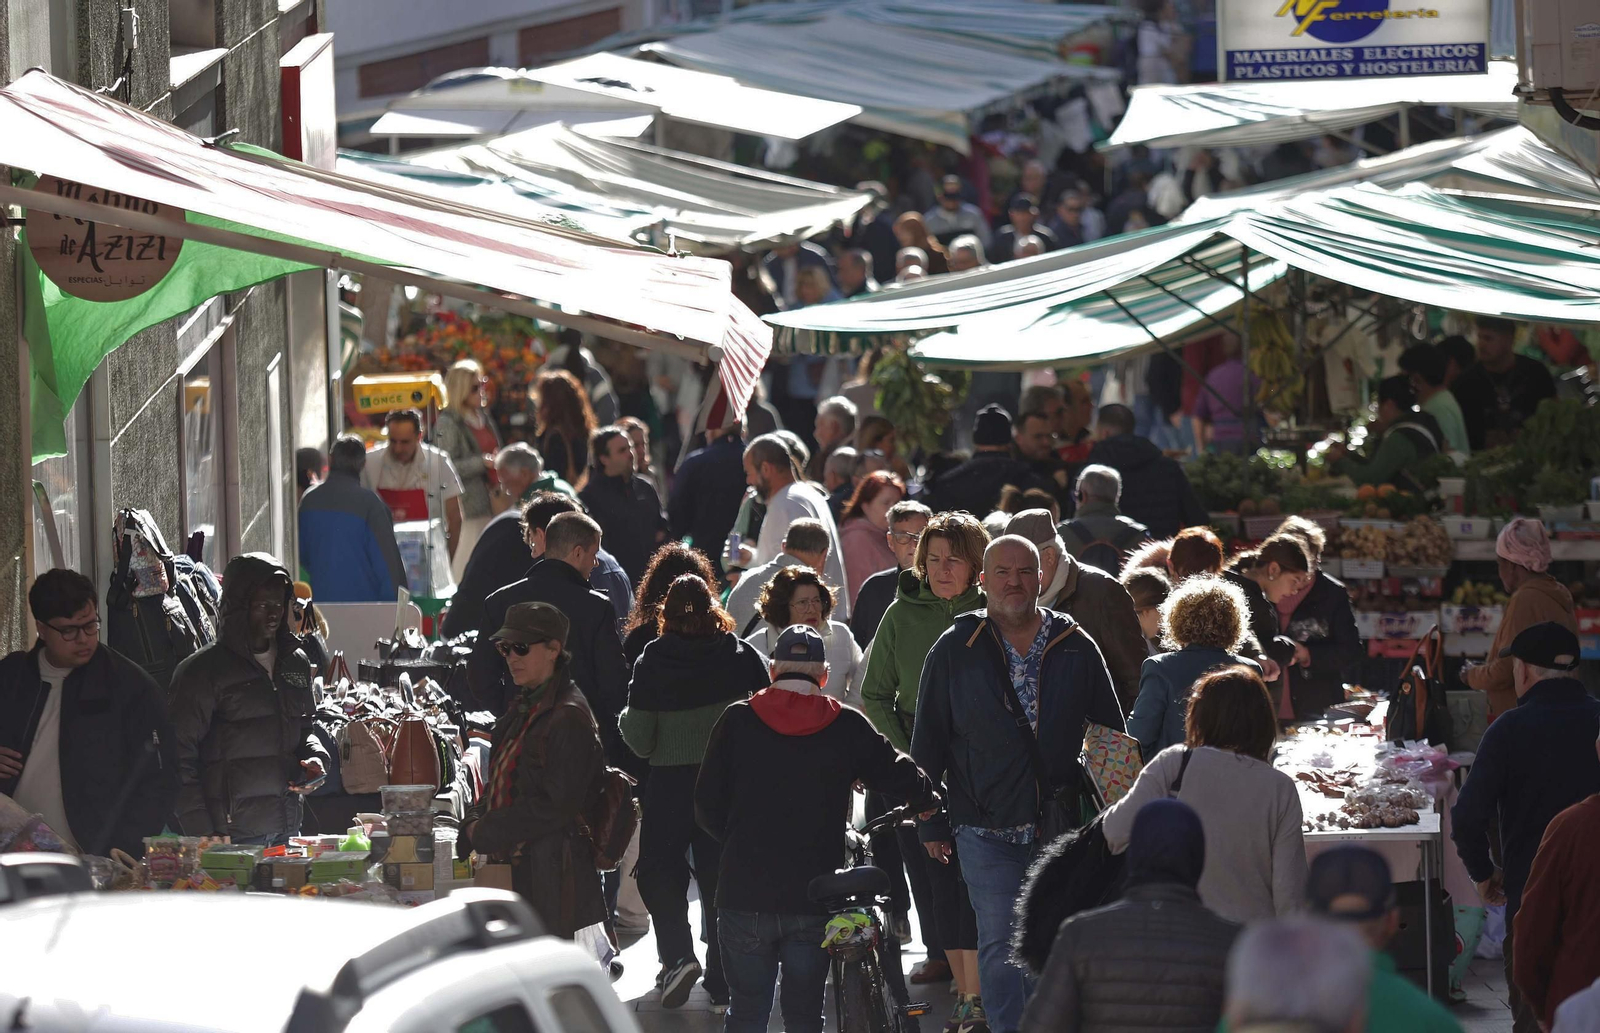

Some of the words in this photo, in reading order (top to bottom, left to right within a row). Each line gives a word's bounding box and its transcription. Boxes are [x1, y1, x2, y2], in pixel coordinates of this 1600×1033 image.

[1233, 48, 1354, 64] MATERIALES
[1363, 44, 1480, 60] ELECTRICOS
[1234, 62, 1338, 79] PLASTICOS
[1342, 63, 1356, 76] Y
[1358, 60, 1479, 76] HOSTELERIA
[60, 234, 76, 256] de
[372, 395, 403, 406] ONCE
